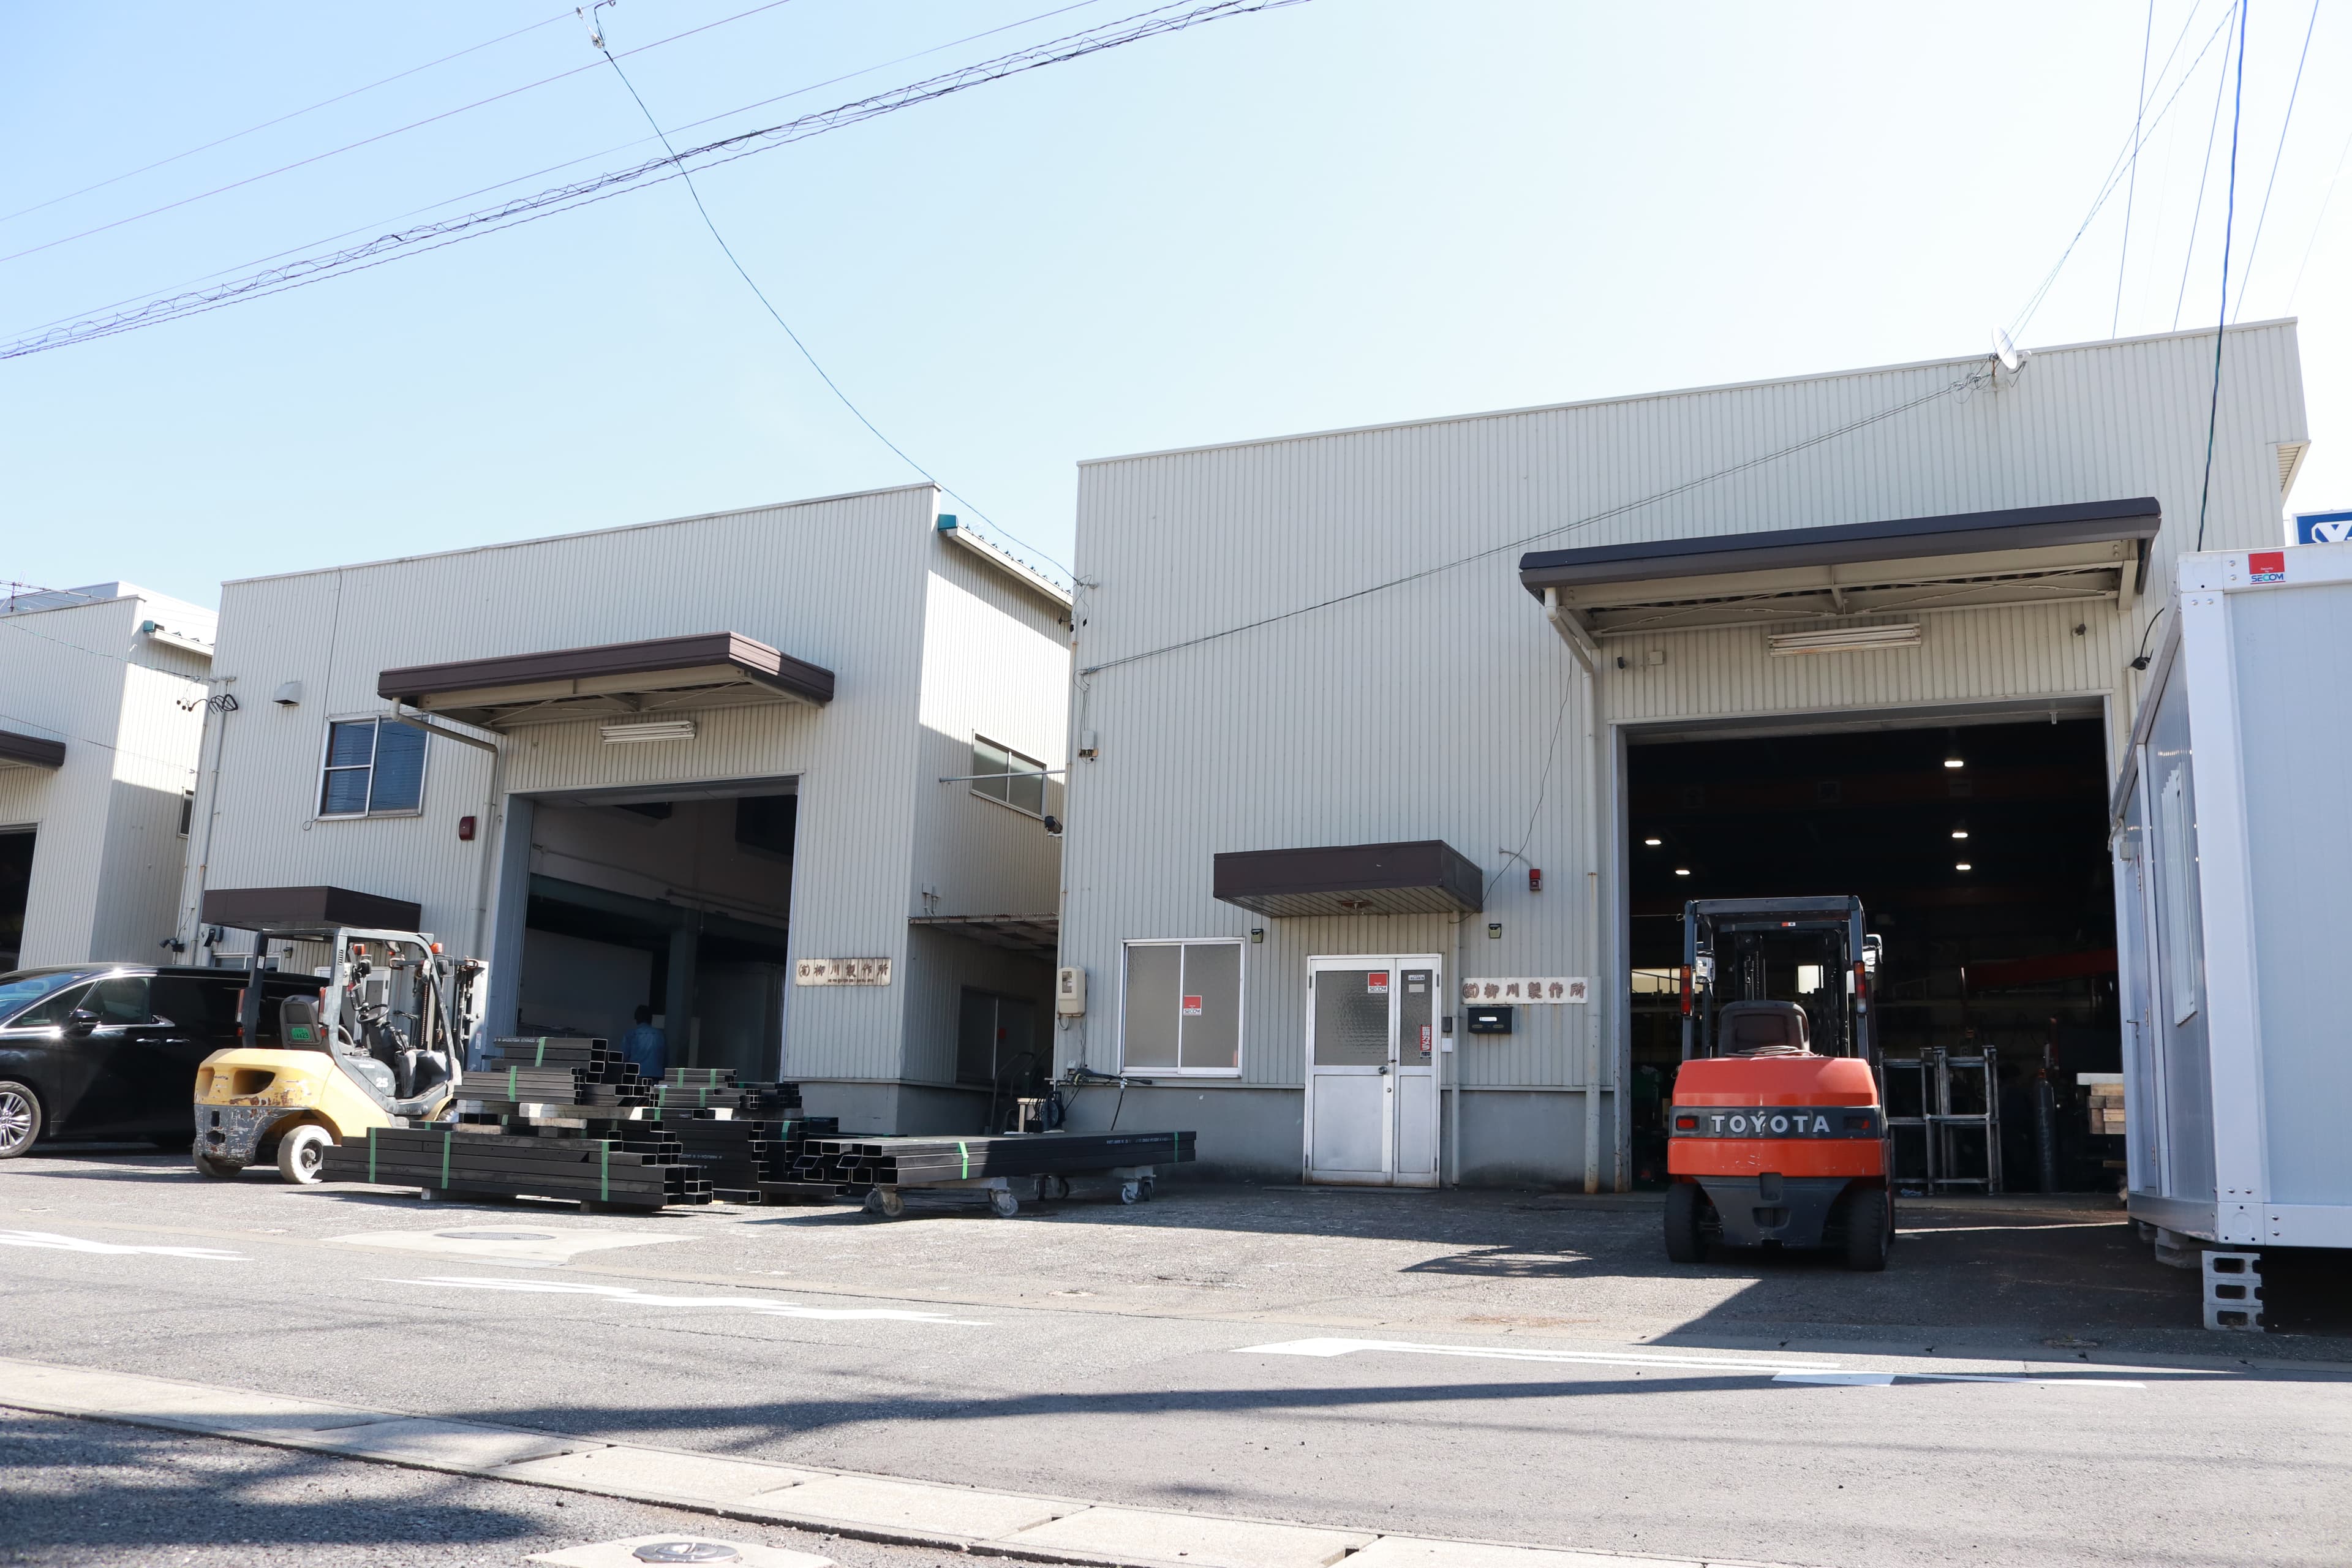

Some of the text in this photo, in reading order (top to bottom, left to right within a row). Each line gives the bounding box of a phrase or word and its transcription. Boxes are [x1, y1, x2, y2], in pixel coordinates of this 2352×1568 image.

[2251, 573, 2284, 582] SECOM
[375, 1077, 388, 1088] 25
[1711, 1115, 1831, 1133] TOYOTA
